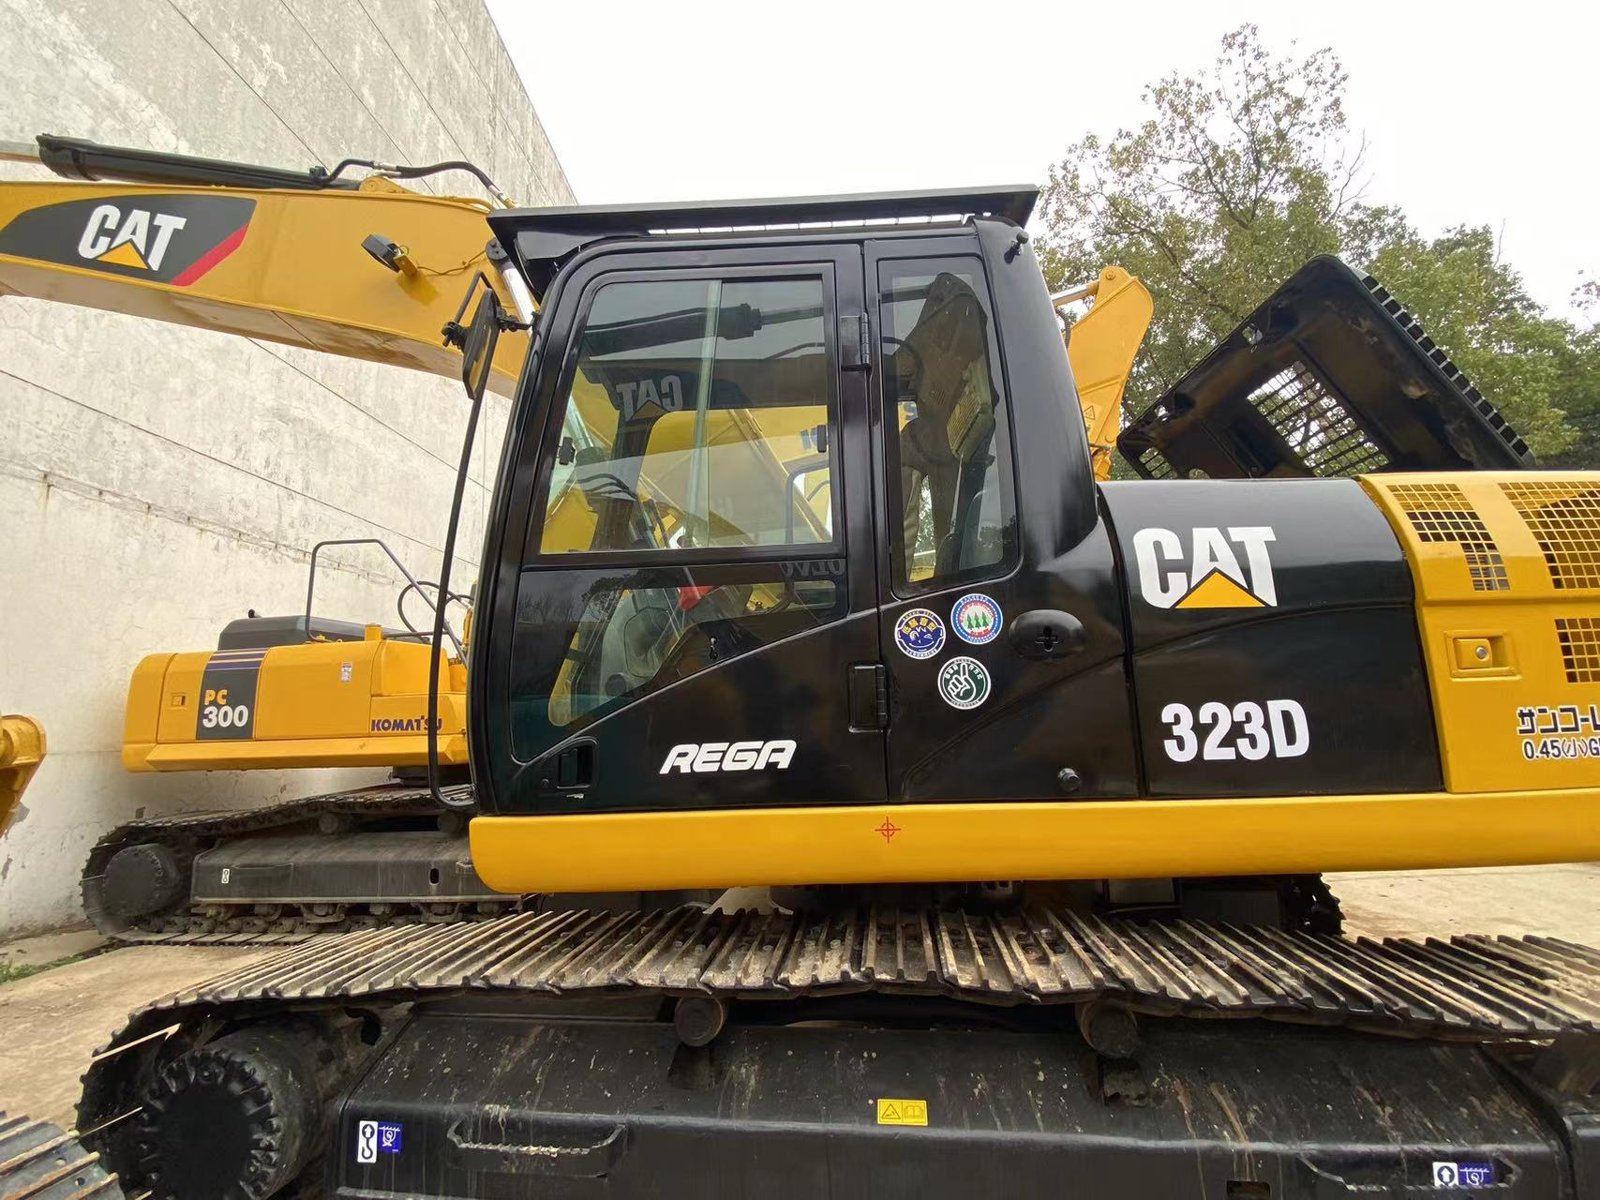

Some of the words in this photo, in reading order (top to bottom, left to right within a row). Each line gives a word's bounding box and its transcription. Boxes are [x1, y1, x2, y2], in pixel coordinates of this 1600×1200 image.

[77, 204, 187, 270] CAT
[1133, 526, 1278, 608] CAT
[202, 705, 249, 728] 300
[204, 689, 228, 705] PC
[1161, 699, 1311, 762] 323D
[659, 739, 797, 774] REGA
